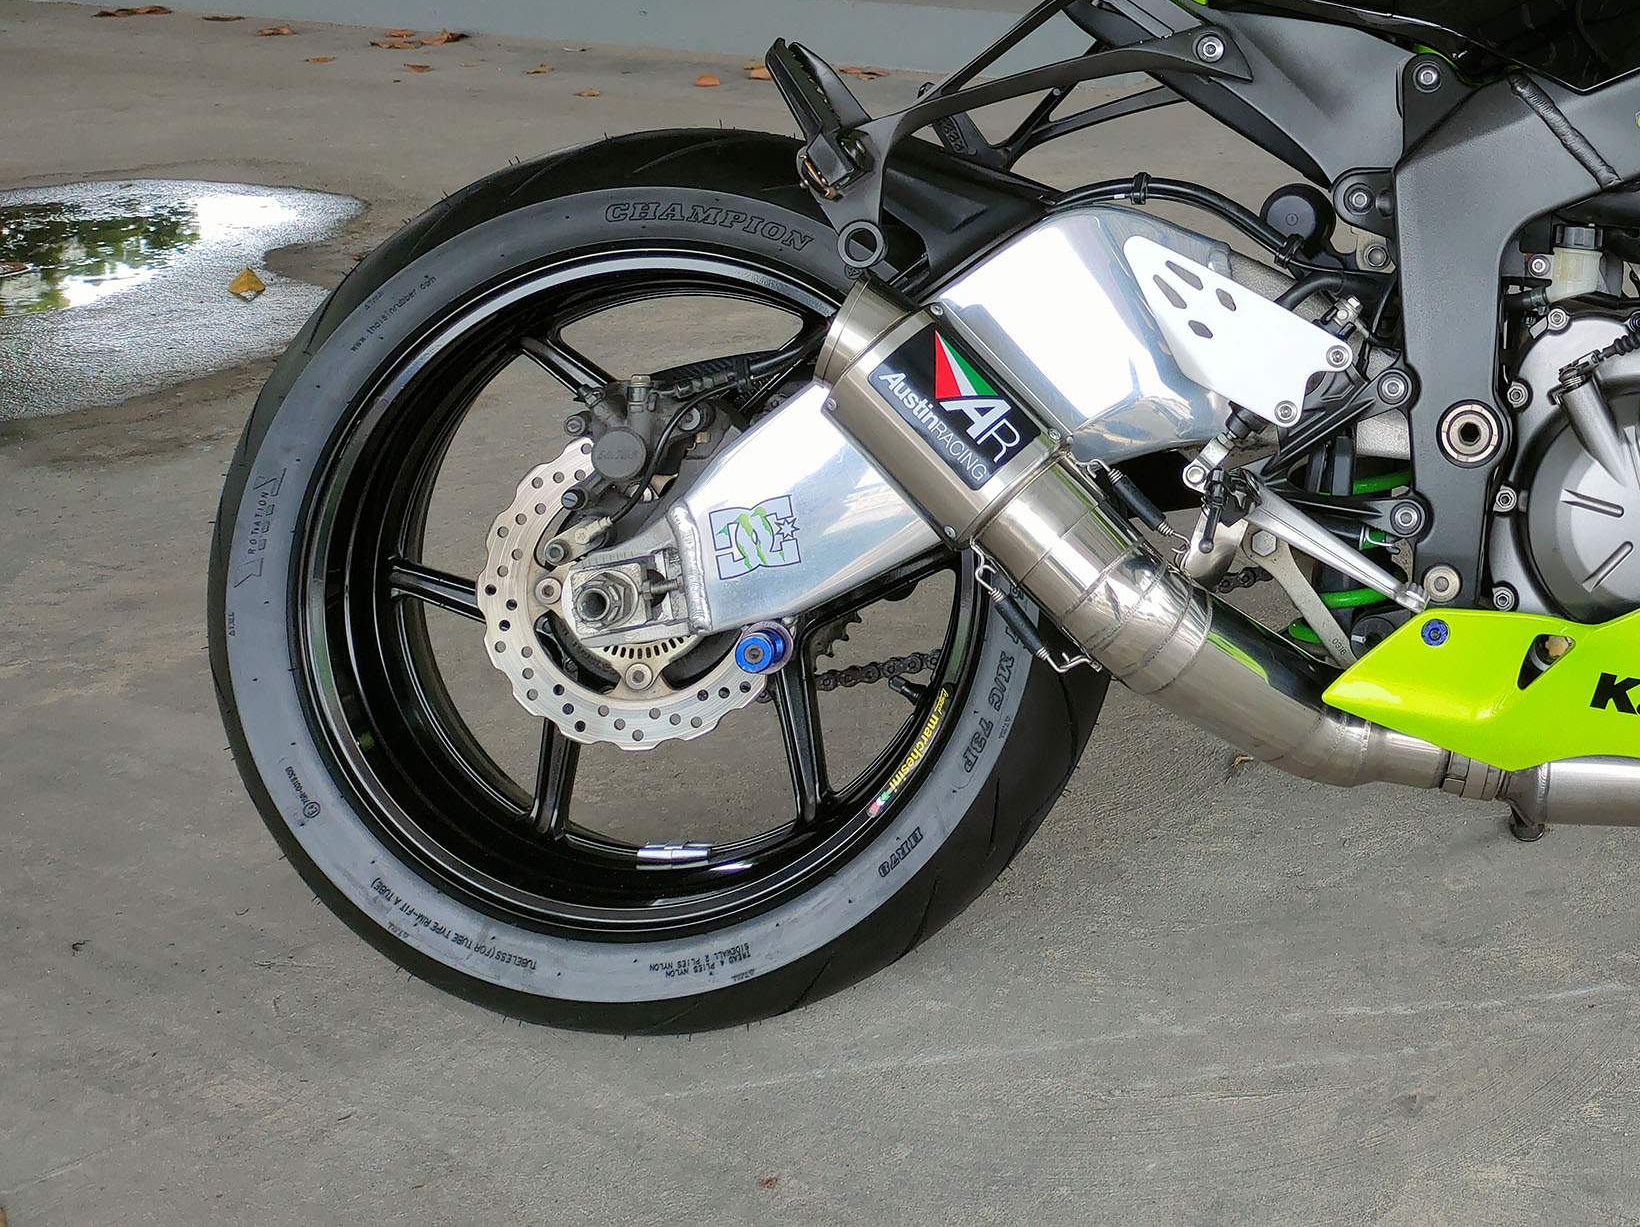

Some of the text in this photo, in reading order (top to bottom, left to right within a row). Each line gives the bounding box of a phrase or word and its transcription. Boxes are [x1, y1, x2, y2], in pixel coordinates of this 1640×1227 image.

[605, 202, 813, 251] CHAMPION
[888, 713, 939, 793] marchesini
[964, 717, 994, 773] 73P
[451, 932, 473, 949] TUBE
